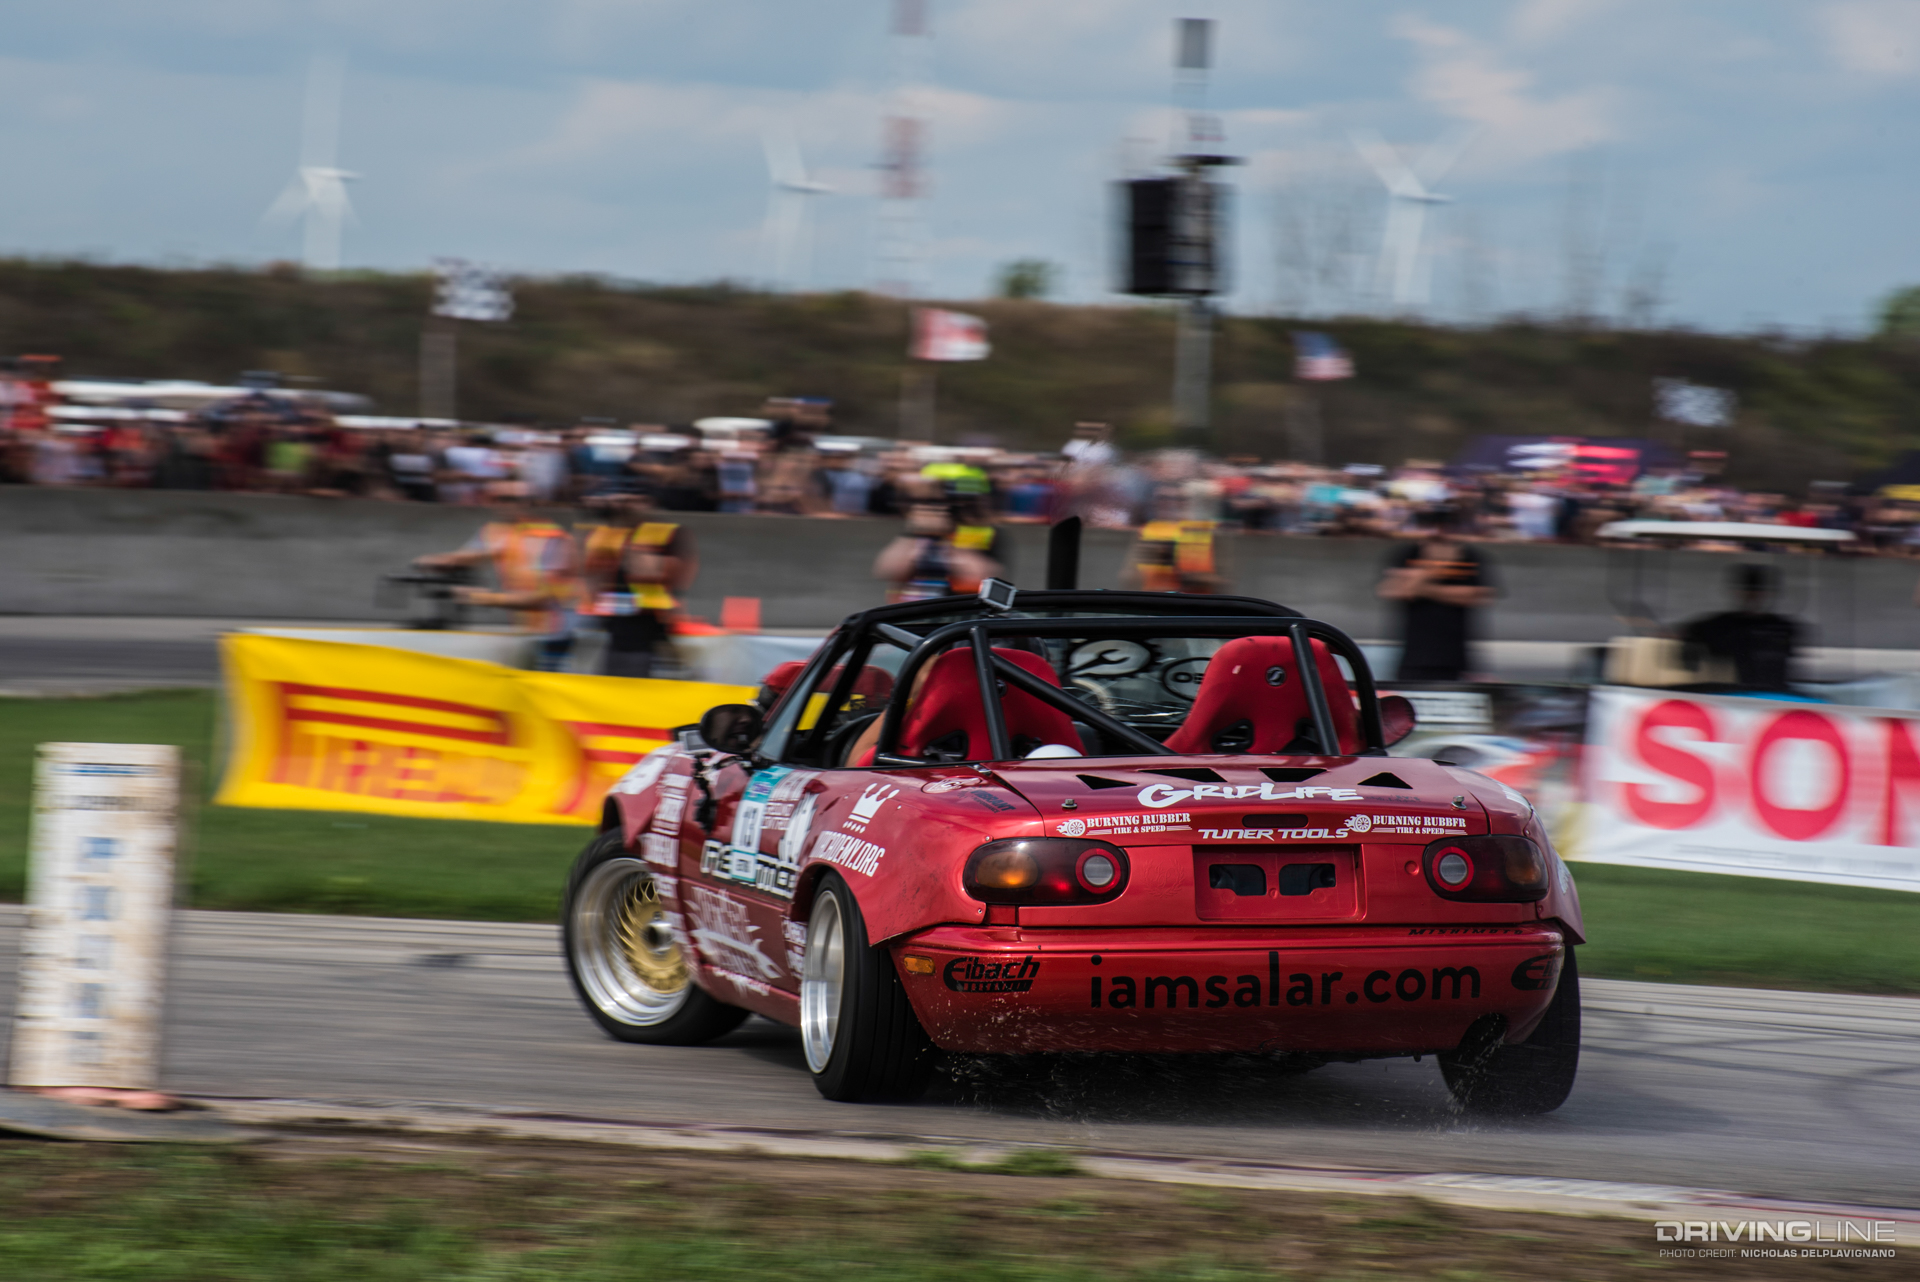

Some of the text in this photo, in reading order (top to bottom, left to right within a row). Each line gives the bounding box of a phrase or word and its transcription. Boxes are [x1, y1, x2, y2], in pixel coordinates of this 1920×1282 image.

[1086, 815, 1140, 828] BURNING
[1372, 814, 1421, 826] BURNING
[1113, 826, 1132, 835] TIRE
[1140, 825, 1166, 833] SPEED
[1198, 828, 1349, 841] TUNER TOOLS
[1395, 826, 1414, 834] TIRE
[1421, 827, 1445, 835] SPEED
[1408, 928, 1524, 936] MISHIMOTO
[943, 955, 1041, 992] Eibach
[1090, 951, 1481, 1009] iamsalar.com
